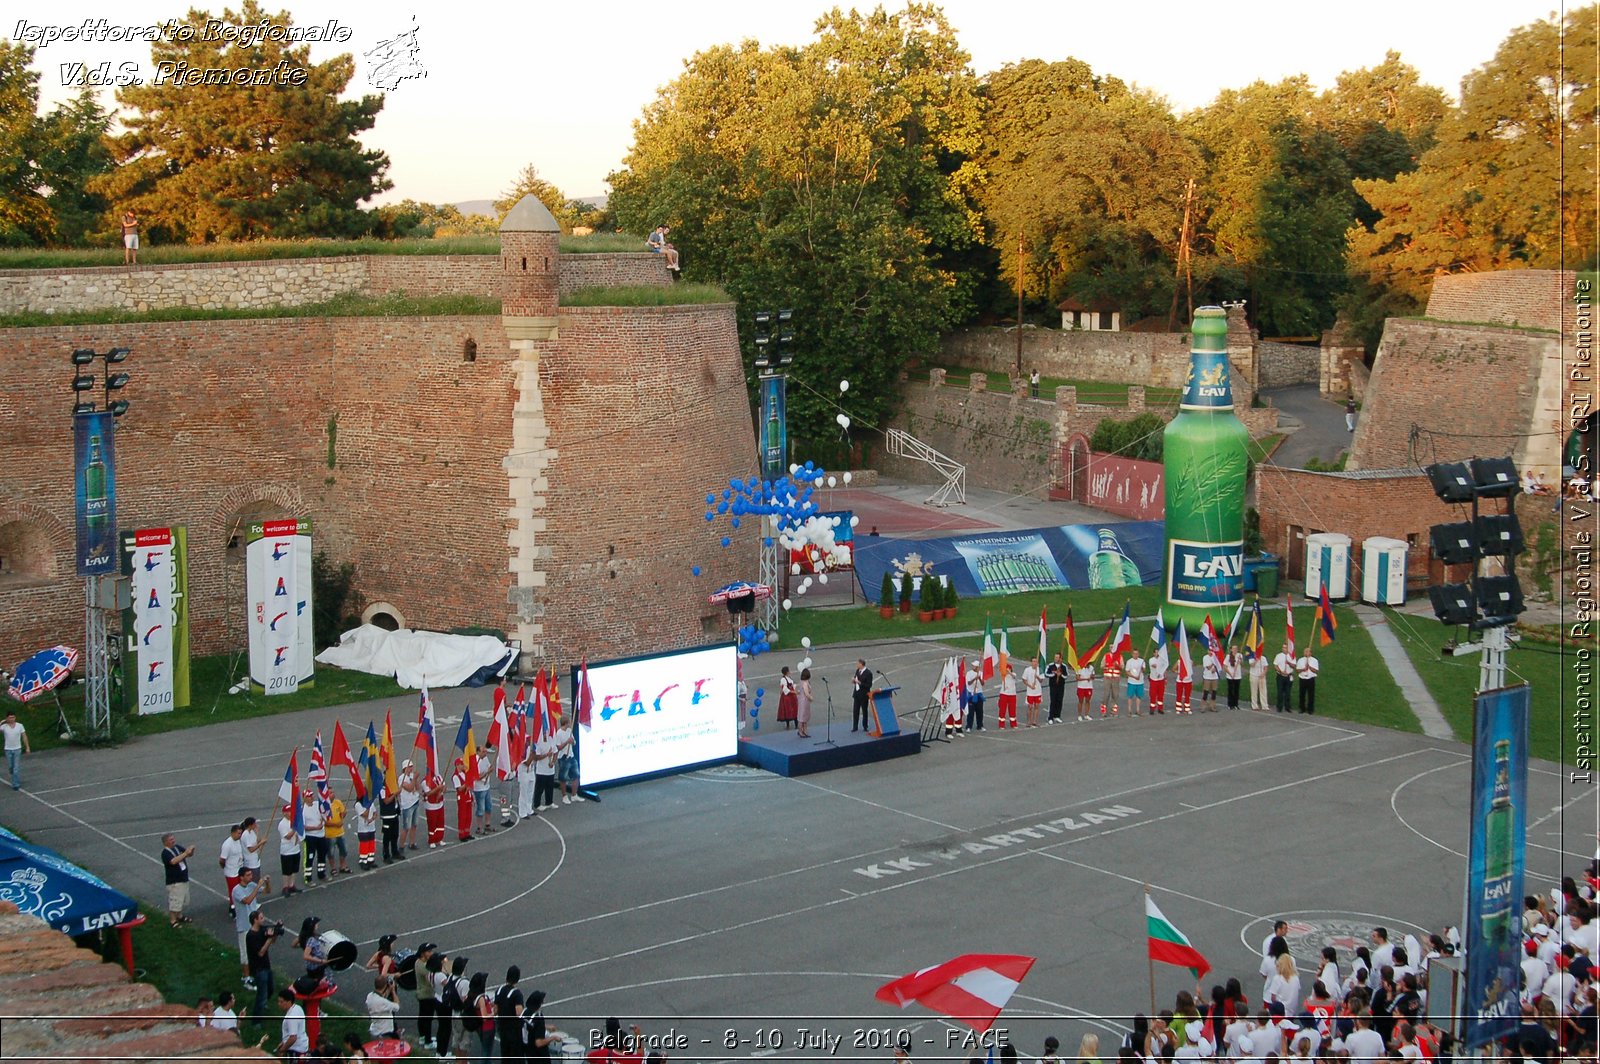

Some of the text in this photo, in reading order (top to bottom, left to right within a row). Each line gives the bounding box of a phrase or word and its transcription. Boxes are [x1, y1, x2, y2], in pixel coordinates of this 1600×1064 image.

[1199, 387, 1226, 396] LAV
[87, 500, 107, 510] LAV
[85, 556, 109, 567] LAV
[1183, 553, 1243, 578] LAV
[269, 675, 296, 689] 2010
[143, 691, 171, 706] 2010
[853, 857, 932, 879] KK
[1484, 880, 1511, 900] LAV
[82, 909, 128, 931] LAV
[1478, 999, 1508, 1025] LAV
